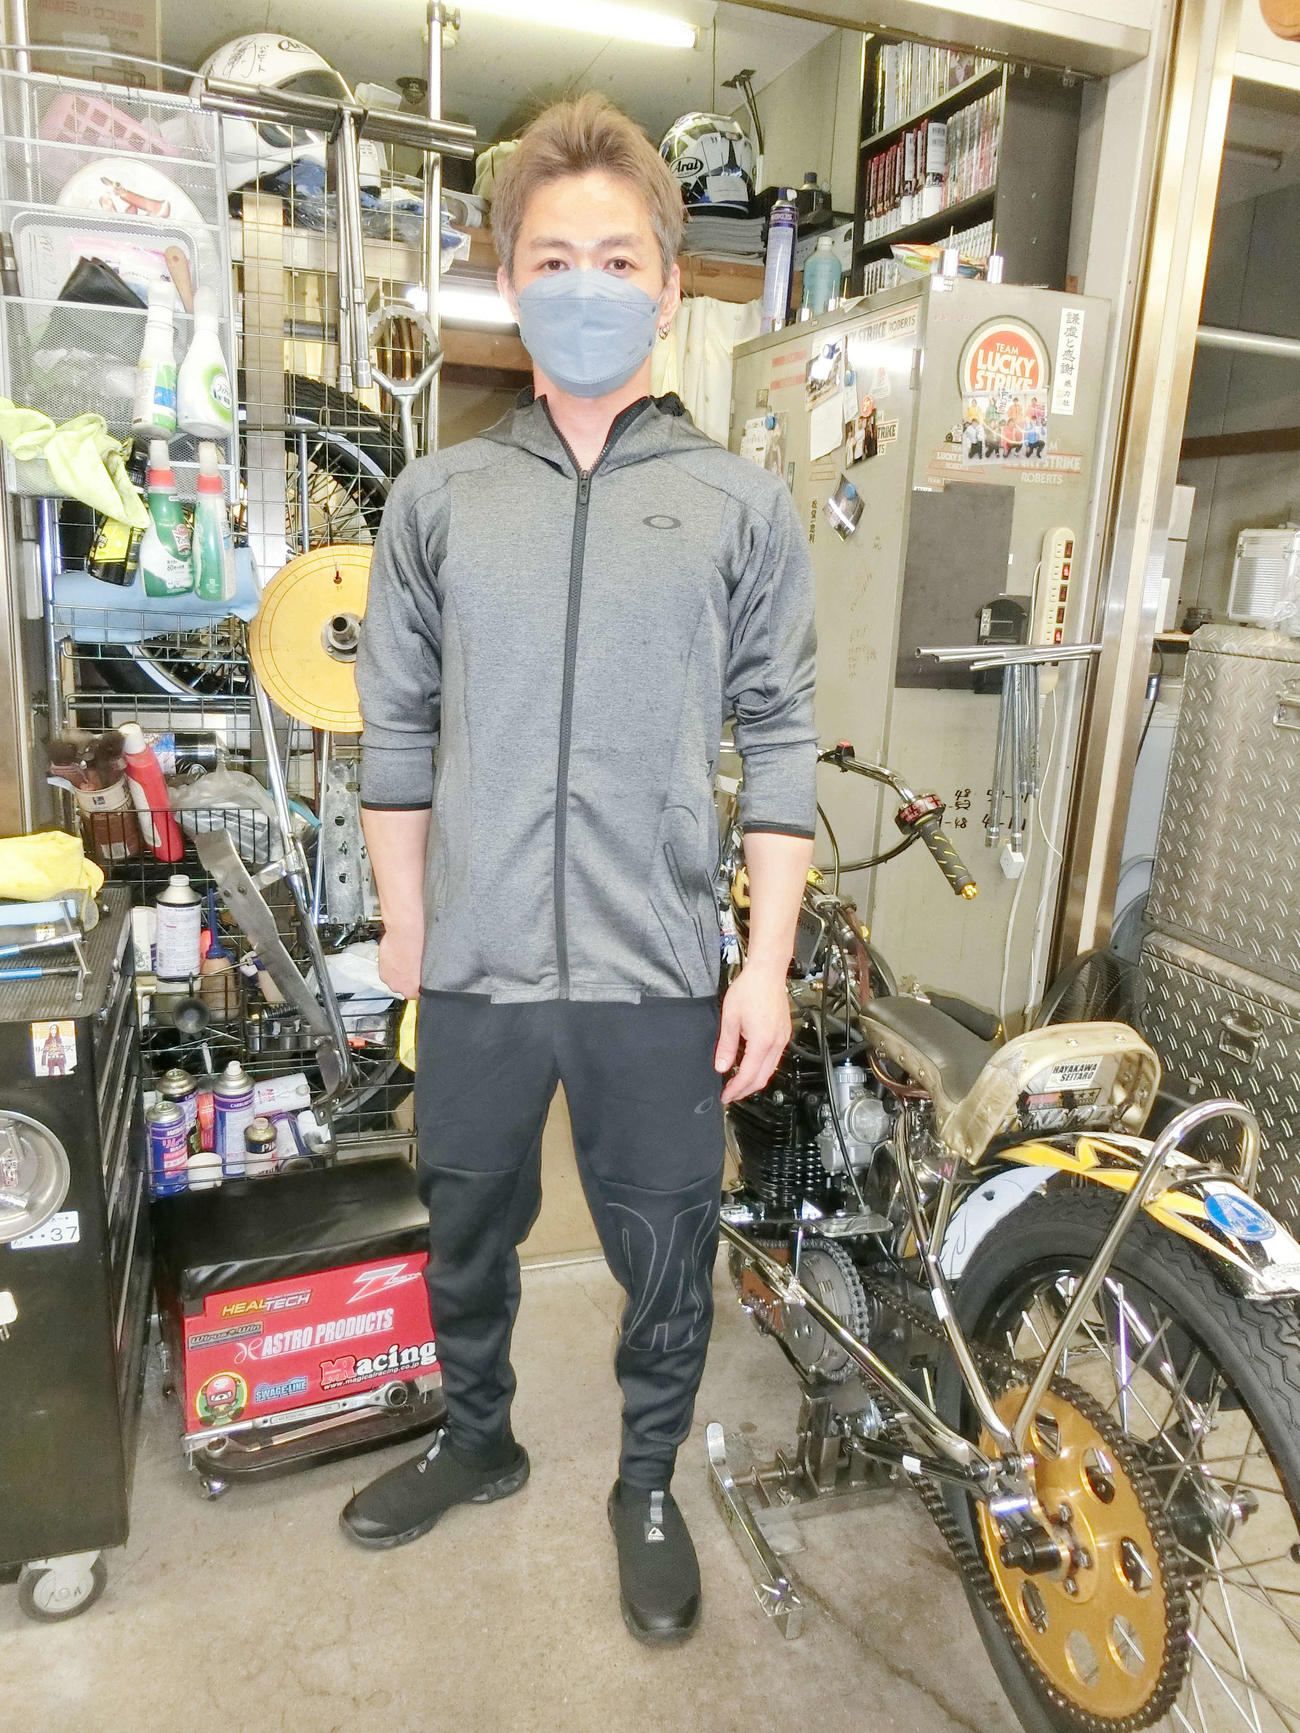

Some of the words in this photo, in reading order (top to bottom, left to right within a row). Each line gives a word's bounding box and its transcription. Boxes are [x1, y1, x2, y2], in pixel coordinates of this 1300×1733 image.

[995, 343, 1019, 355] TEAM
[977, 349, 1035, 378] LUCKY
[877, 424, 897, 439] TRIKE
[1021, 472, 1063, 485] ROBERTS
[1052, 1063, 1098, 1074] HAYAKAWA
[1060, 1071, 1095, 1082] SEITARO
[222, 1292, 311, 1317] HEALTECH
[262, 1325, 313, 1358] ASTRO
[315, 1308, 394, 1345] PRODUCTS
[255, 1377, 307, 1402] SWAGE-LINE
